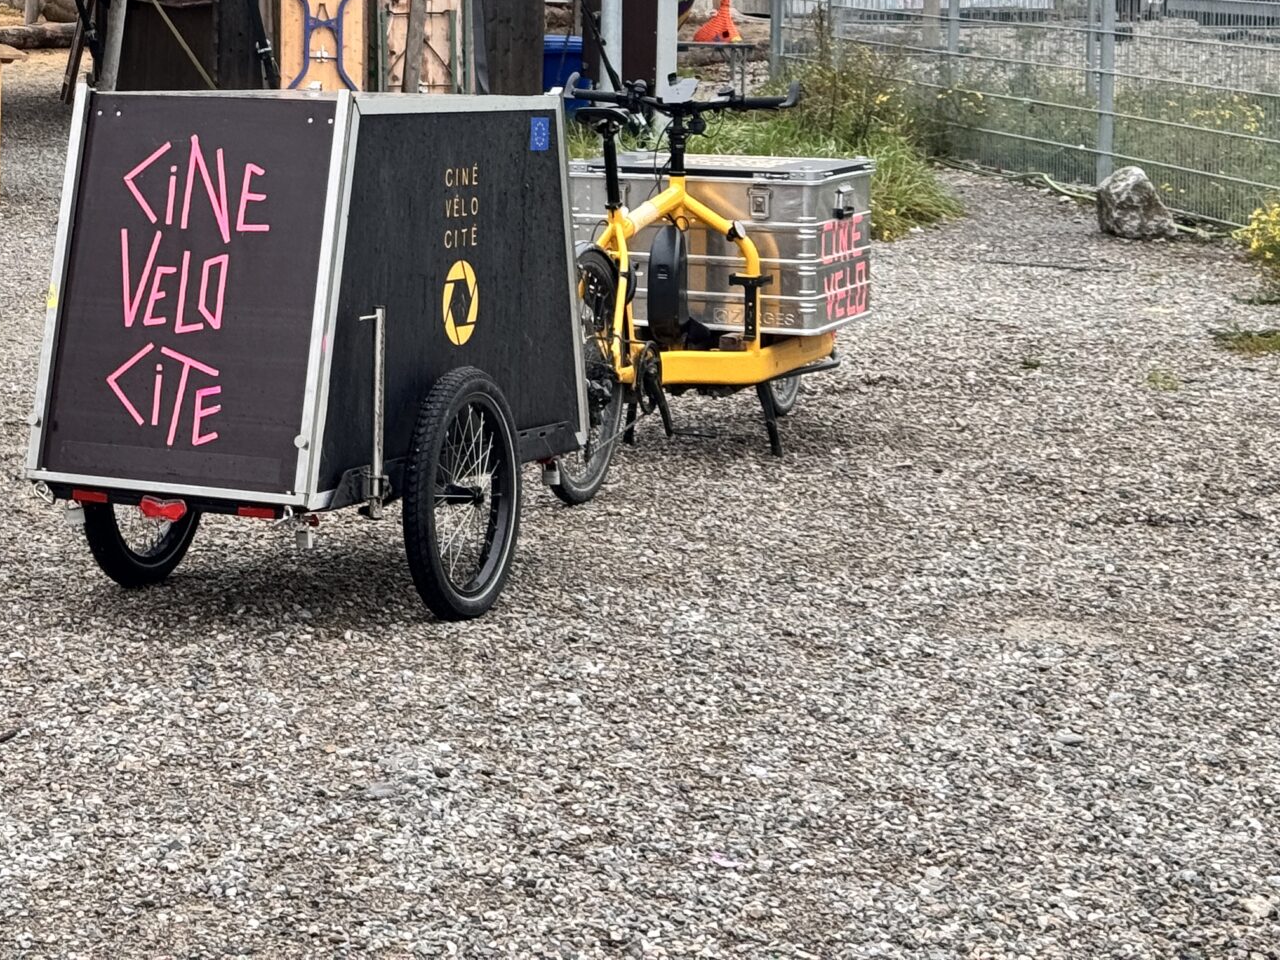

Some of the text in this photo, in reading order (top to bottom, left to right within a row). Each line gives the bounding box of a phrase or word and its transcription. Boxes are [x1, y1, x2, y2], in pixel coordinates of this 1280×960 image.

[445, 162, 479, 187] CINÉ
[445, 194, 479, 218] VÉLO
[444, 223, 478, 248] CITÉ
[821, 215, 864, 264] CINE
[121, 228, 229, 334] VELO
[823, 261, 867, 320] VELO
